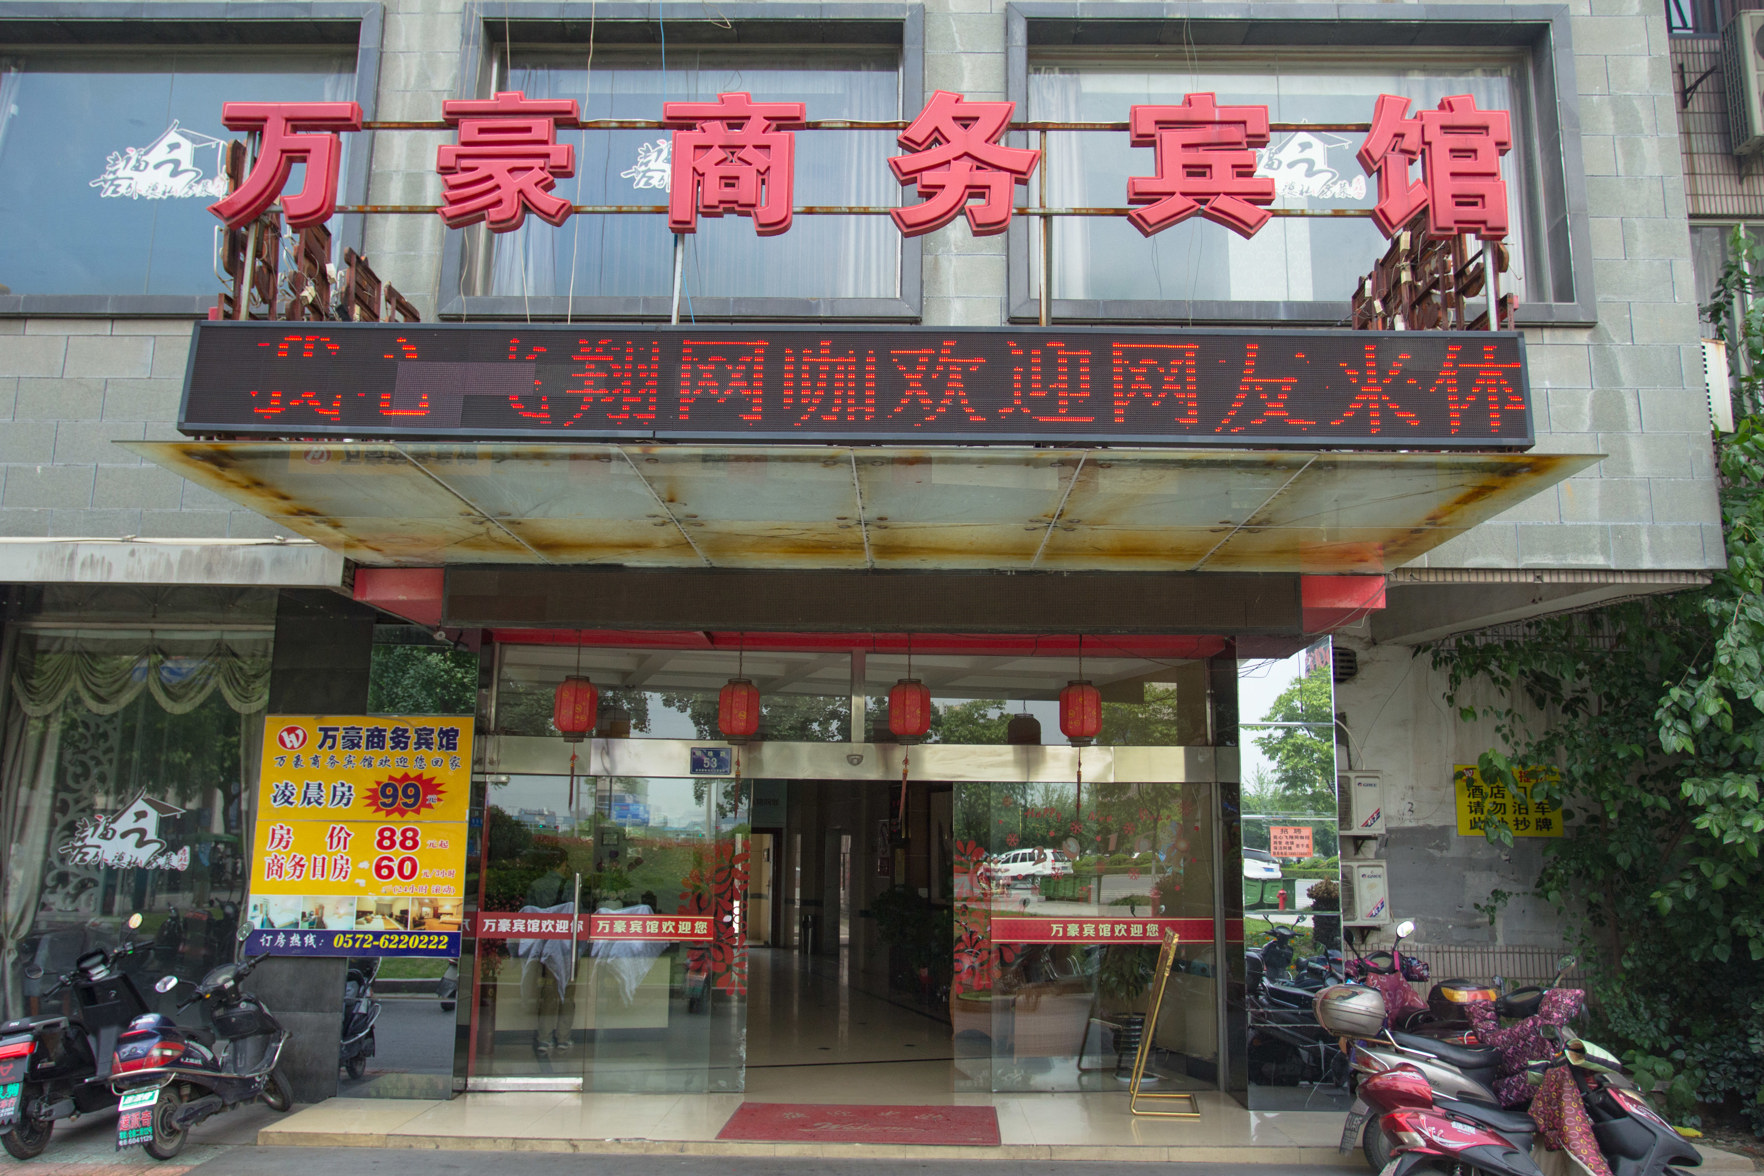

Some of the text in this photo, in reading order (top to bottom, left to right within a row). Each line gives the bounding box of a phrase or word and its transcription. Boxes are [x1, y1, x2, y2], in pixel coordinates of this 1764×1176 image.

[207, 91, 1513, 241] 万豪商务宾馆
[317, 726, 460, 751] 万豪商务宾馆
[274, 754, 462, 770] 万豪商务宾馆欢迎您回家
[703, 758, 717, 768] 53
[271, 780, 354, 808] 凌晨房
[379, 781, 422, 809] 99
[1467, 801, 1551, 815] 请勿泊车
[1469, 817, 1553, 831] 此抄牌
[267, 823, 449, 851] 房价 88 元起
[265, 853, 351, 881] 商务日房
[373, 855, 418, 881] 60
[483, 918, 584, 933] 万豪宾馆欢迎你
[597, 920, 708, 934] 万豪宾馆欢迎您
[1050, 923, 1160, 937] 万豪宾馆欢迎您
[333, 933, 449, 949] 0572-6220222
